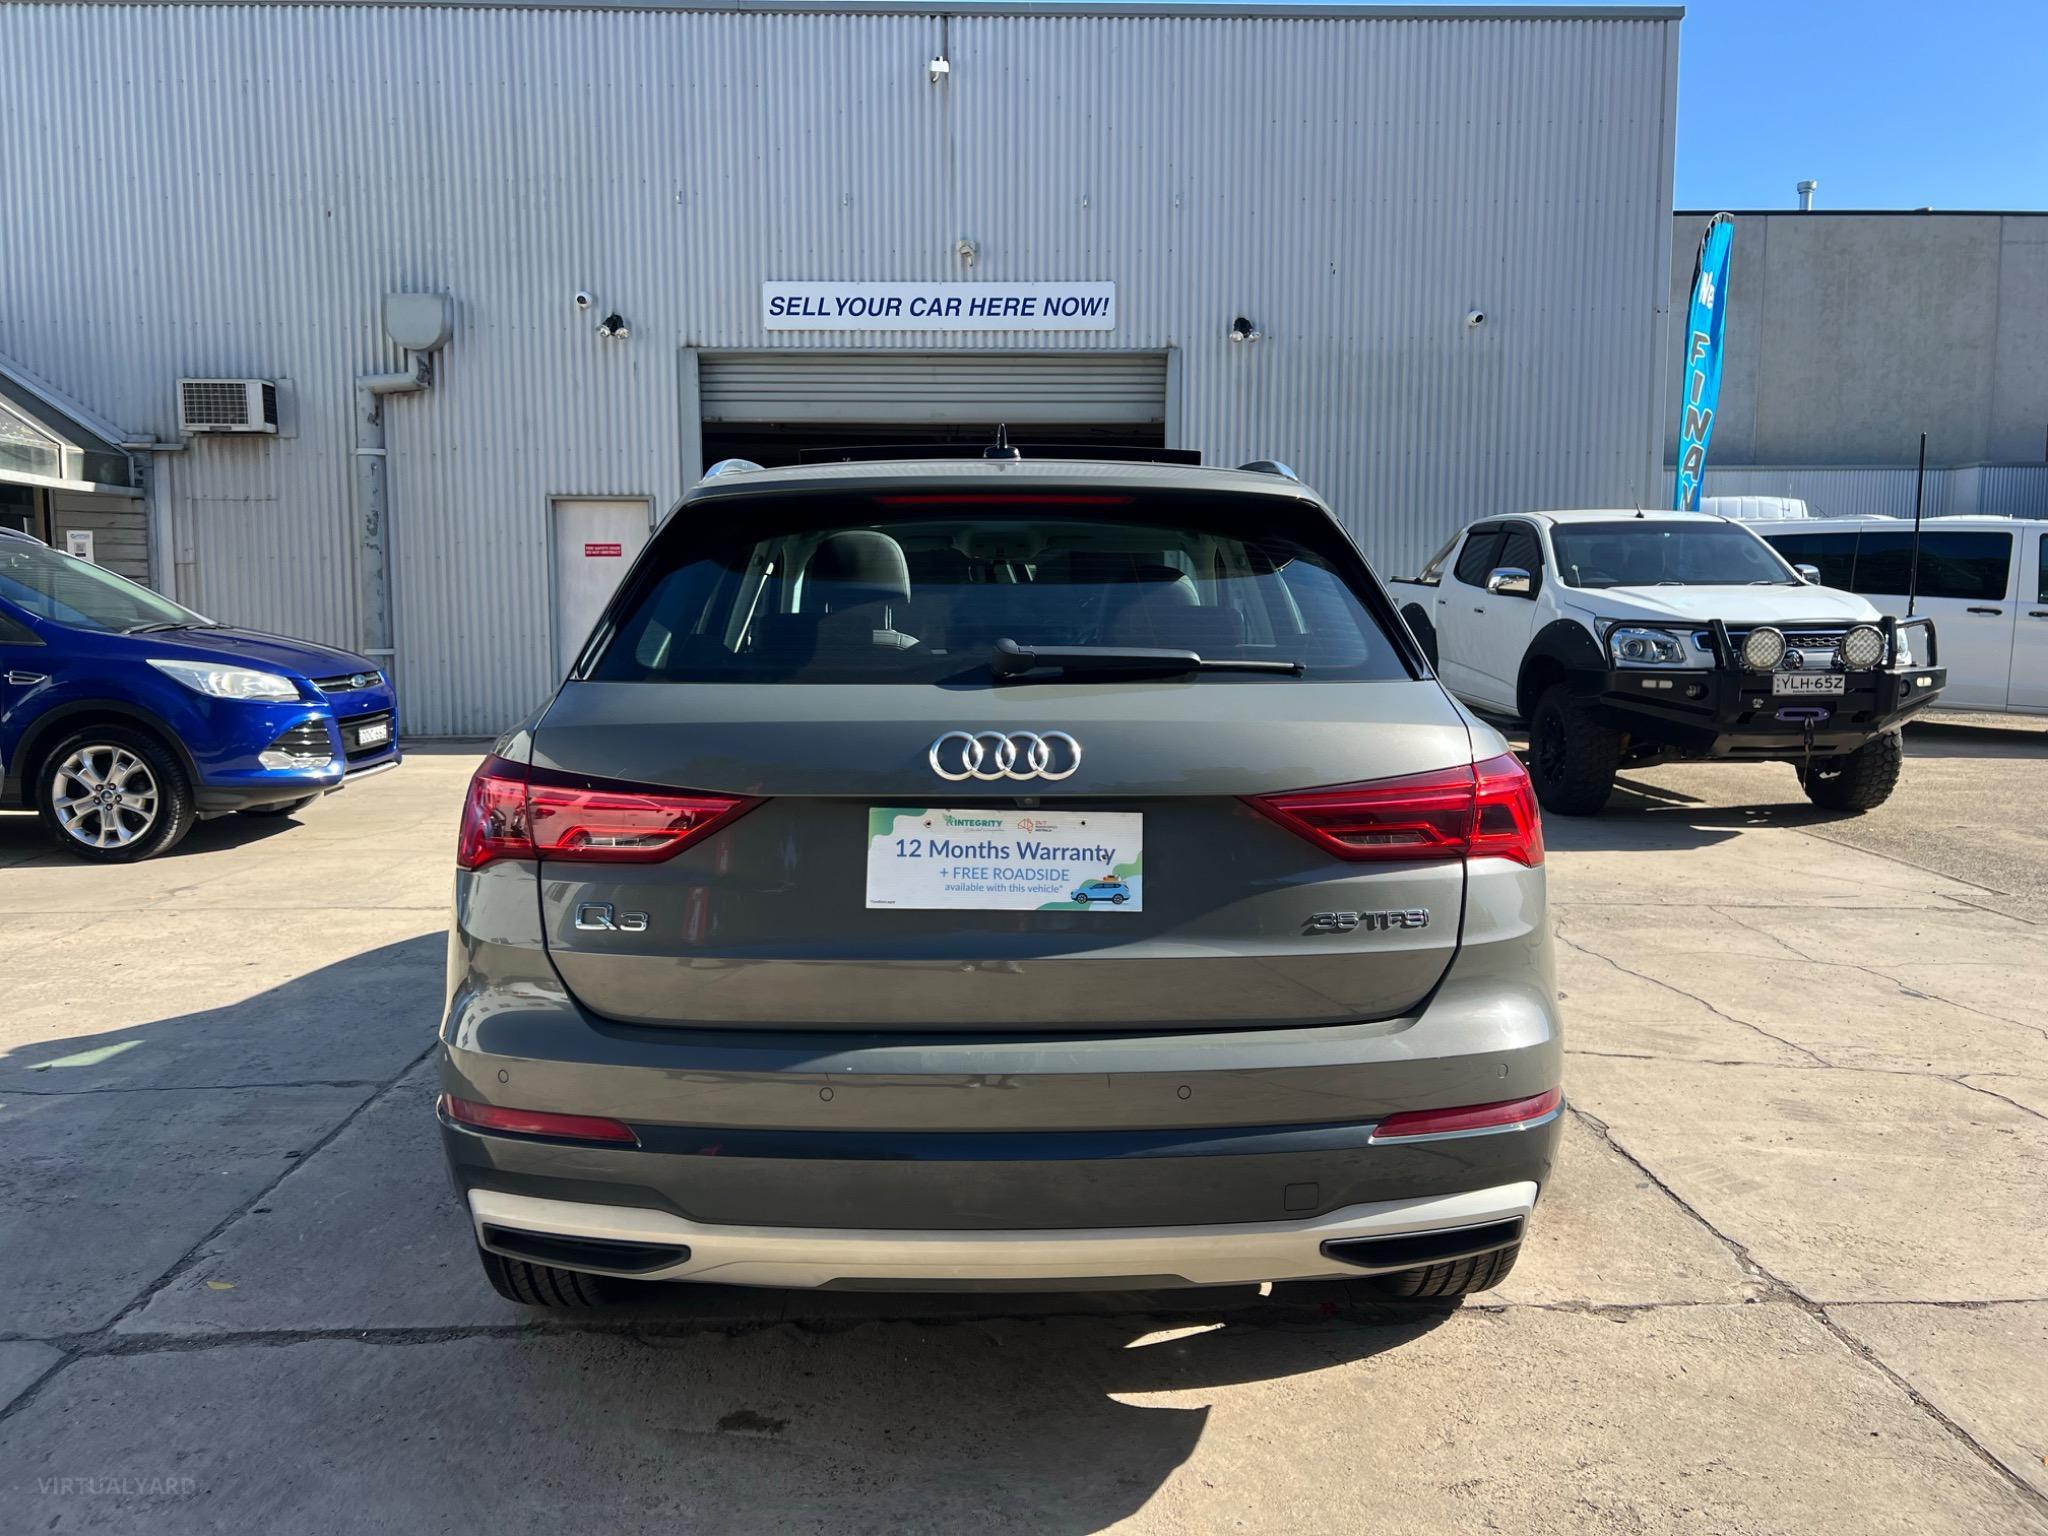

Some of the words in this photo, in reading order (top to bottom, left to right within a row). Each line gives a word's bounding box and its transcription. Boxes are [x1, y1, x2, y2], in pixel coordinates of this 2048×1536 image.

[769, 296, 831, 316] SELL
[835, 296, 901, 317] YOUR
[909, 296, 962, 317] CAR
[968, 297, 1037, 317] HERE
[1043, 297, 1110, 317] NOW!
[954, 819, 1003, 828] INTEGRITY
[896, 838, 922, 858] 12
[928, 839, 1010, 860] Months
[1016, 841, 1116, 866] Warranty
[953, 866, 989, 880] FREE
[993, 867, 1070, 882] ROADSIDE
[944, 882, 984, 893] available
[986, 882, 1007, 893] with
[1009, 883, 1026, 893] this
[576, 902, 648, 932] Q3
[1312, 911, 1359, 930] 35
